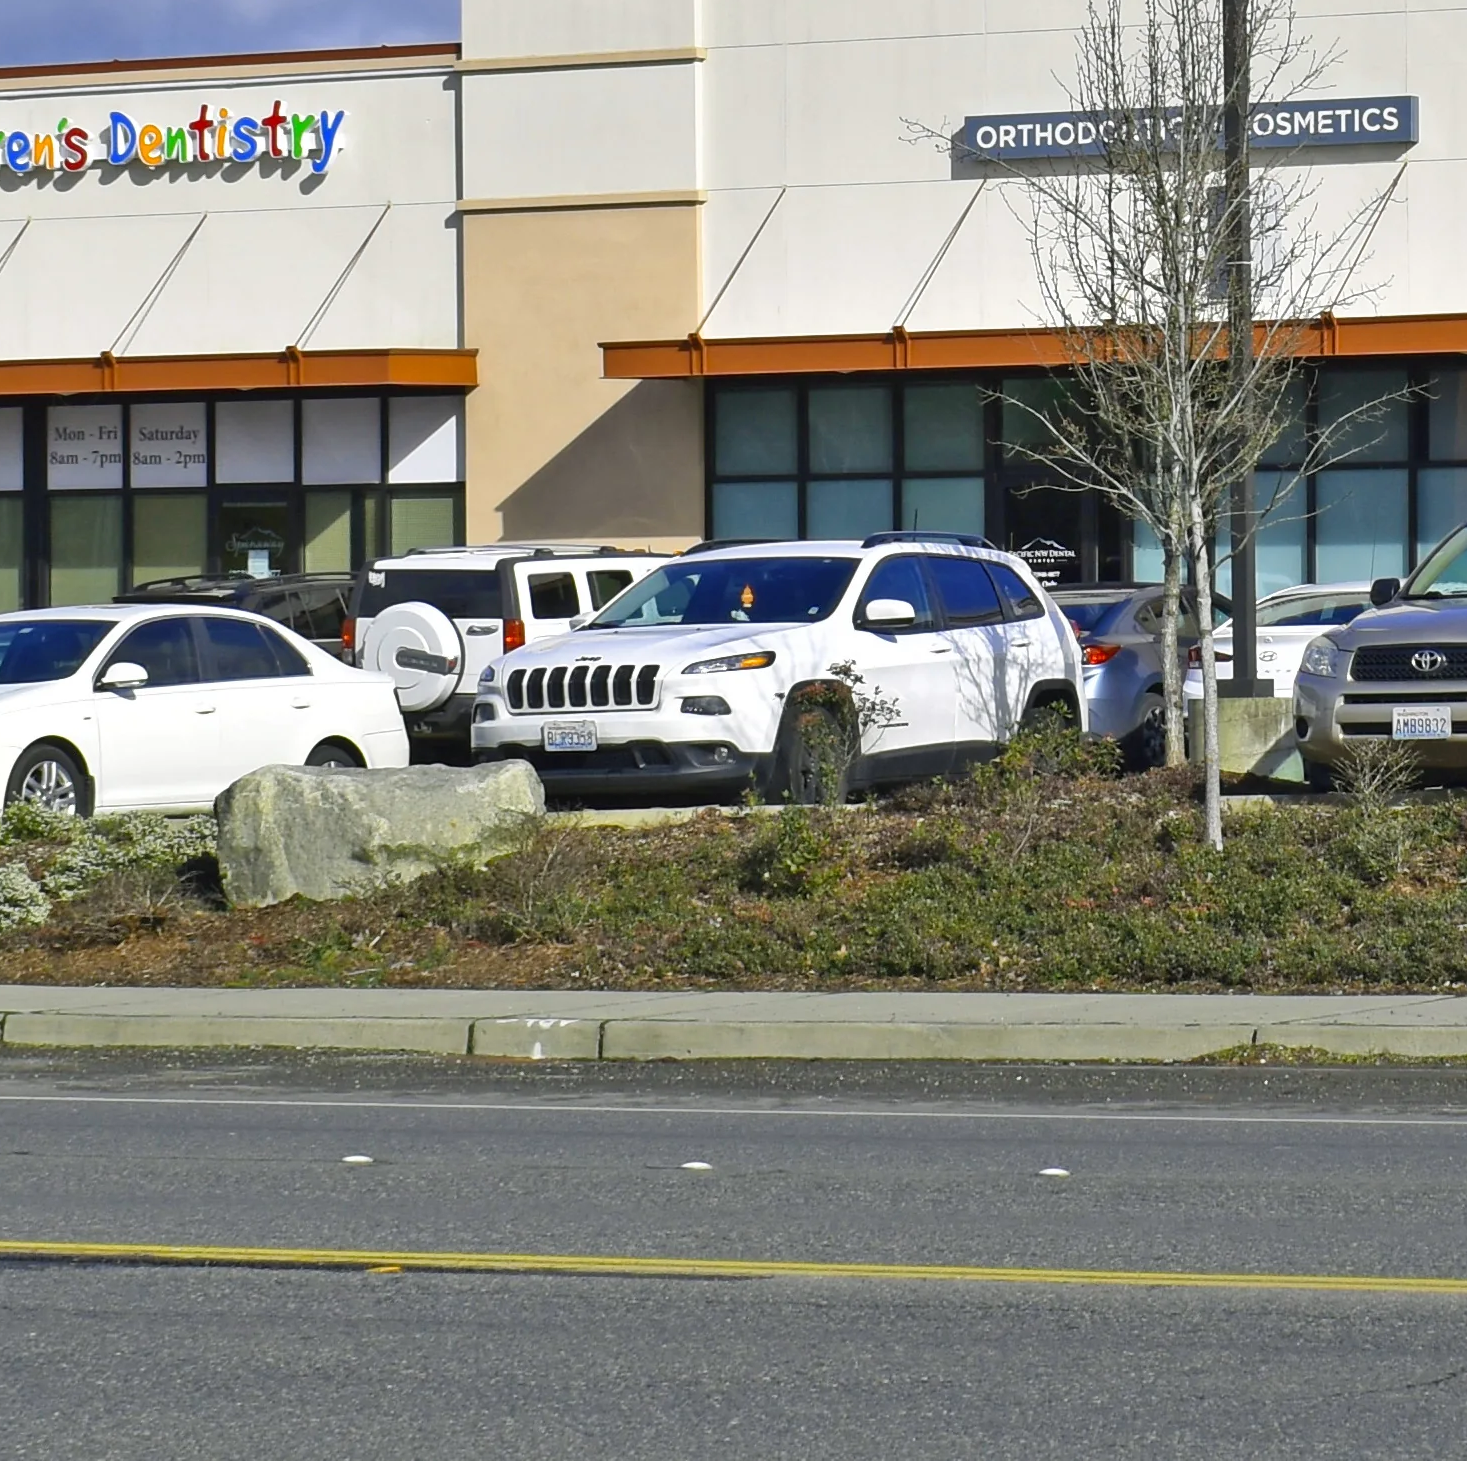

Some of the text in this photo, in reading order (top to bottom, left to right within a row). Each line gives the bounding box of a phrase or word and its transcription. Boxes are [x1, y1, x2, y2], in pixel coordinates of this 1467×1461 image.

[1247, 106, 1399, 138] OSMETICS
[108, 98, 346, 175] Dentistry
[54, 426, 85, 441] Mon
[98, 425, 118, 440] Fri
[138, 425, 200, 445] Saturday
[49, 451, 79, 465] 8am
[91, 450, 122, 468] 7pm
[133, 451, 162, 465] 8am
[175, 450, 206, 469] 2pm
[1395, 718, 1447, 735] AMB9832
